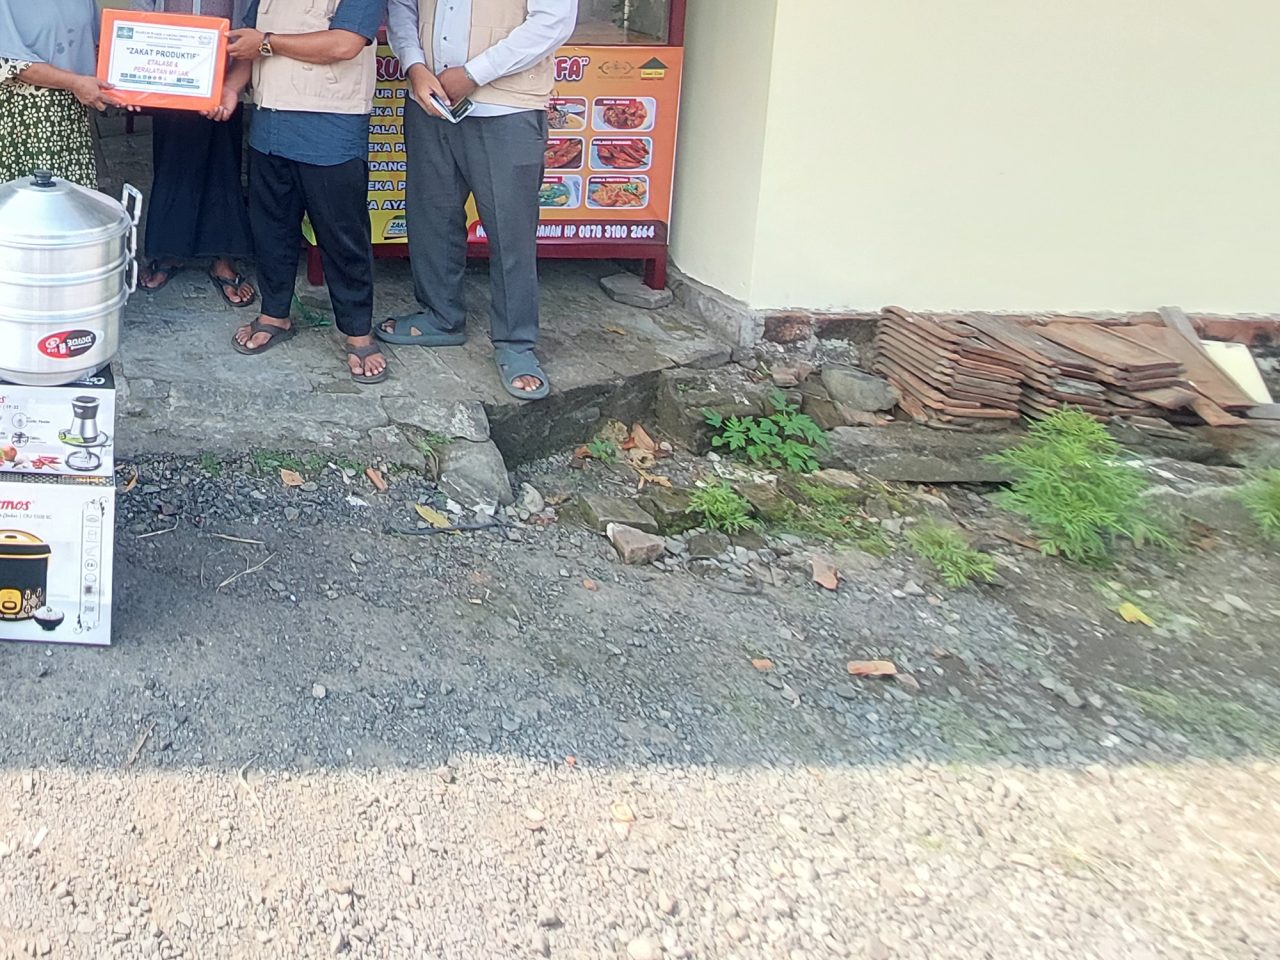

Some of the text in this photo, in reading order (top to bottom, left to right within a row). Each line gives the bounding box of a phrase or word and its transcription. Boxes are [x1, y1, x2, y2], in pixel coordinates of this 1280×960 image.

[147, 59, 173, 67] ETALASE
[133, 66, 168, 75] PERALATAN
[370, 107, 393, 117] EKA
[369, 125, 398, 135] PALA
[368, 143, 391, 153] EKA
[368, 161, 407, 171] DANG
[368, 181, 394, 191] EKA
[382, 201, 406, 210] AYA
[564, 225, 576, 237] HP
[579, 225, 602, 238] 0878
[605, 225, 628, 238] 3180
[631, 225, 655, 238] 2664
